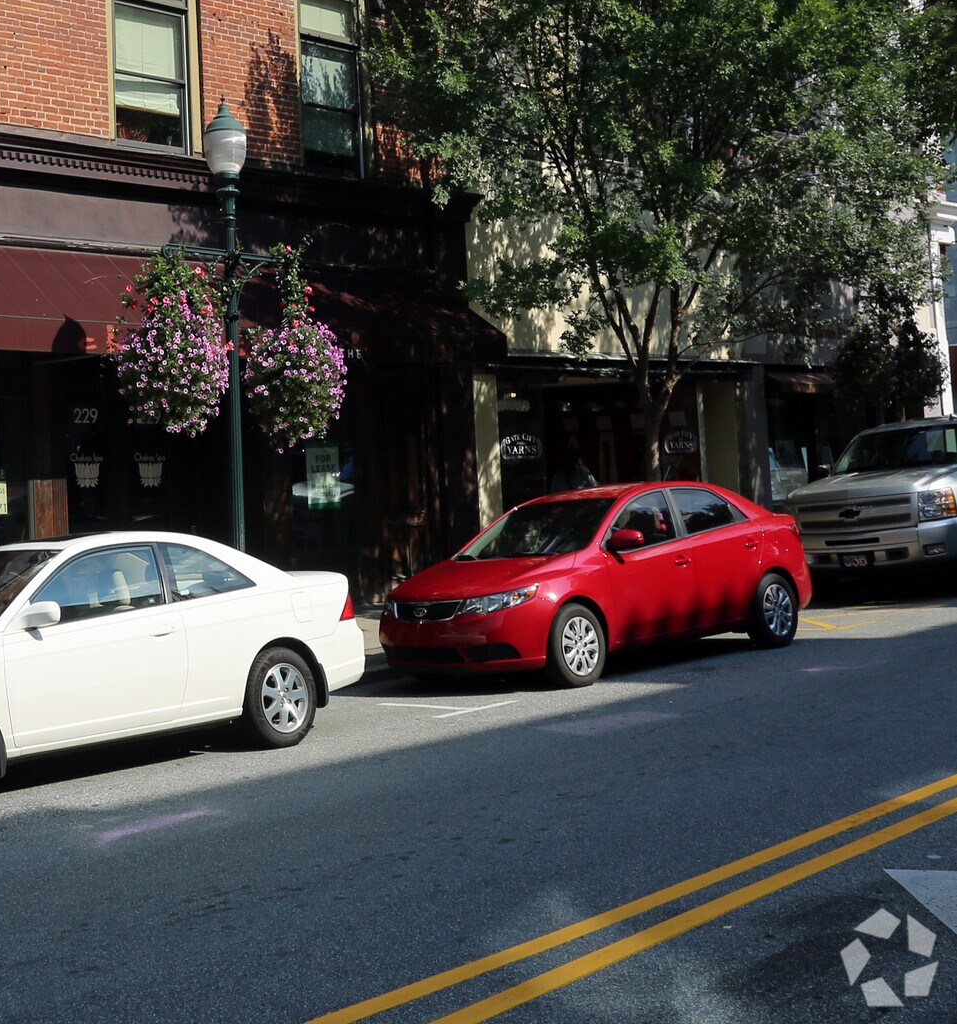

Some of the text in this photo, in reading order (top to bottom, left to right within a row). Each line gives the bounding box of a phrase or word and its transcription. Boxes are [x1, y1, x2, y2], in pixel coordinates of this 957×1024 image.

[73, 407, 99, 424] 229
[505, 433, 537, 445] GATE CITY
[669, 440, 693, 449] YARNS
[506, 445, 537, 455] YARNS
[69, 452, 104, 462] Chakras Spa
[155, 452, 166, 462] Spa
[315, 454, 331, 463] FOR
[311, 464, 336, 473] LEASE
